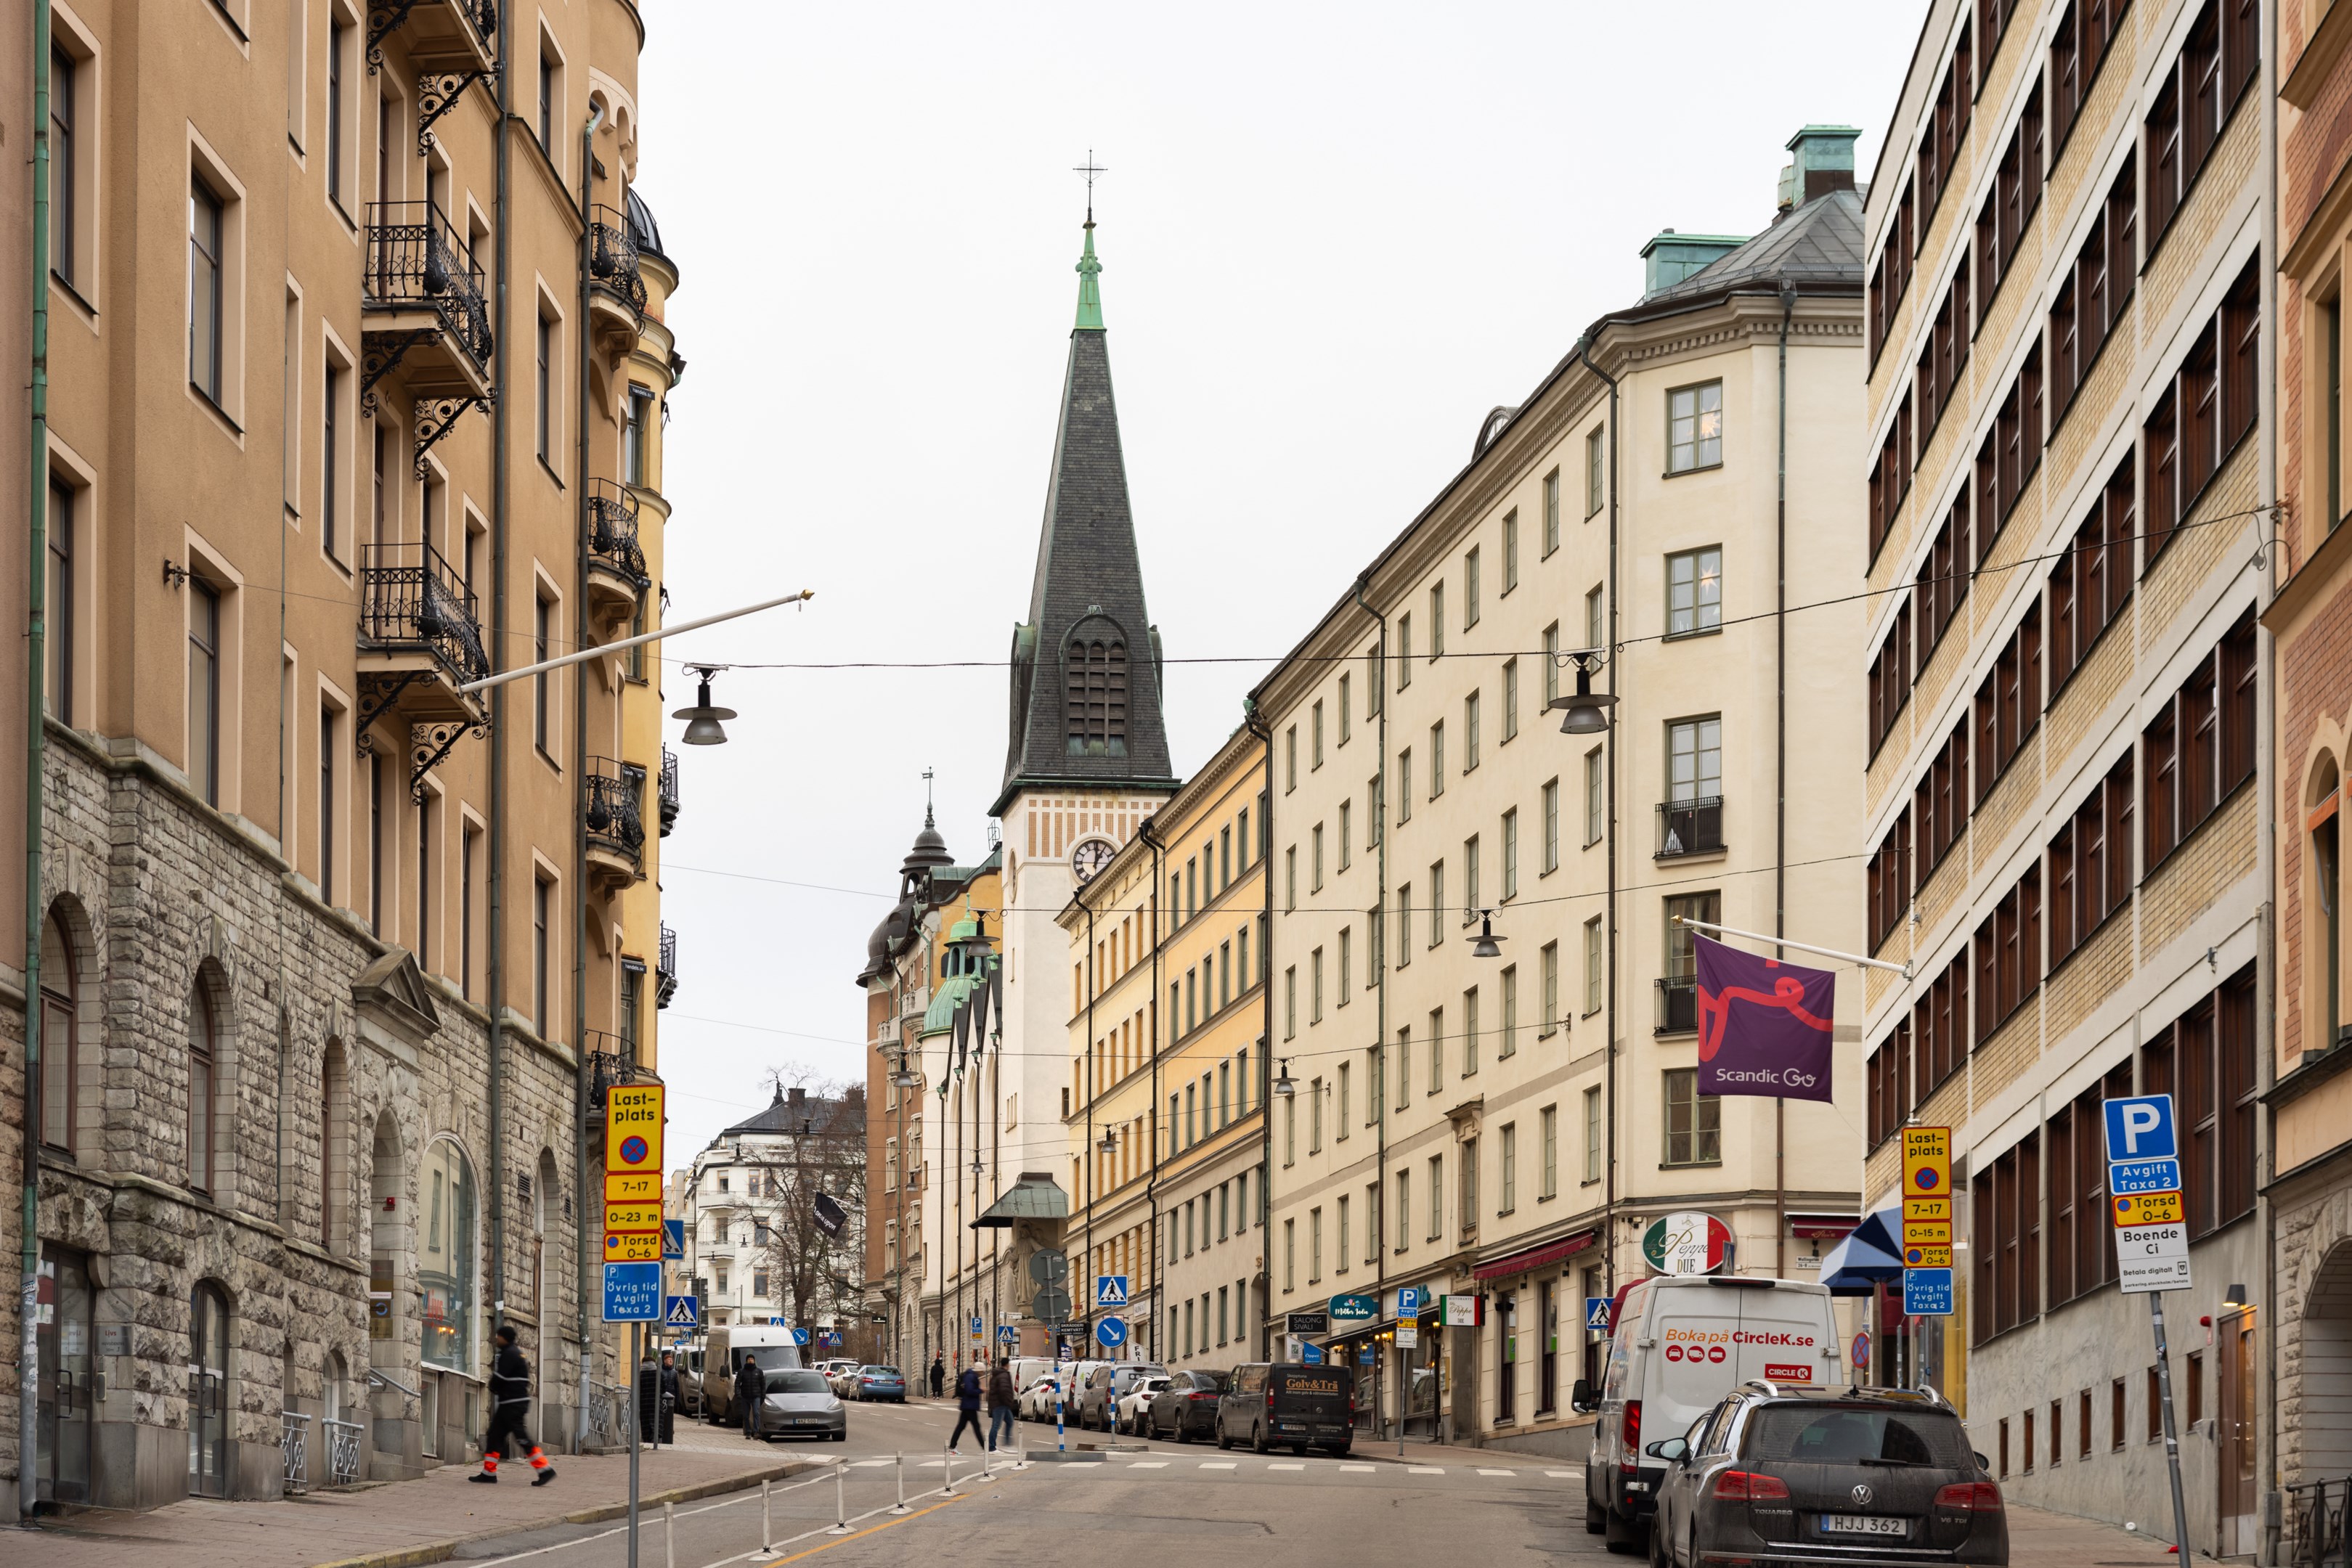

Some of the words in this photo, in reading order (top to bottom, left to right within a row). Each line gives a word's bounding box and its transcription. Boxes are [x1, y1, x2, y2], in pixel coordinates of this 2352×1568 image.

[1715, 1068, 1779, 1084] Scandic
[1783, 1067, 1817, 1087] Go
[614, 1093, 656, 1106] Last-
[616, 1109, 655, 1125] plats
[2122, 1102, 2161, 1154] P
[1908, 1132, 1945, 1144] Last-
[1910, 1146, 1943, 1159] plats
[2122, 1163, 2167, 1177] Avgift
[622, 1182, 648, 1192] 7-17
[2120, 1180, 2157, 1191] Taxa
[2162, 1177, 2171, 1188] 2
[2135, 1194, 2176, 1208] Torsd
[1913, 1204, 1942, 1214] 7-17
[2142, 1209, 2171, 1221] 0-6
[610, 1212, 641, 1222] 0-23
[648, 1214, 658, 1222] m
[622, 1236, 657, 1246] Torsd
[2123, 1228, 2178, 1242] Boende
[1651, 1224, 1721, 1259] Peppe
[627, 1249, 651, 1258] 0-6
[1922, 1247, 1949, 1256] Torsd
[2145, 1243, 2159, 1254] Ci
[1677, 1258, 1696, 1273] DUE
[610, 1267, 617, 1277] P
[607, 1281, 638, 1294] Övrig
[642, 1282, 657, 1291] tid
[1907, 1283, 1934, 1293] Övrig
[614, 1293, 649, 1304] Avgift
[1403, 1290, 1415, 1306] P
[1914, 1292, 1943, 1301] Avgift
[613, 1305, 640, 1314] Taxa
[644, 1305, 651, 1314] 2
[1449, 1304, 1473, 1317] Peppe
[974, 1318, 980, 1327] P
[1666, 1328, 1706, 1342] Boka
[1708, 1329, 1730, 1344] på
[1733, 1331, 1814, 1347] CircleK.se
[1767, 1368, 1796, 1376] CIRCLE
[1799, 1369, 1808, 1378] K
[1285, 1379, 1339, 1389] Golv&Trä
[1834, 1516, 1865, 1531] HJJ
[1869, 1519, 1900, 1533] 362
